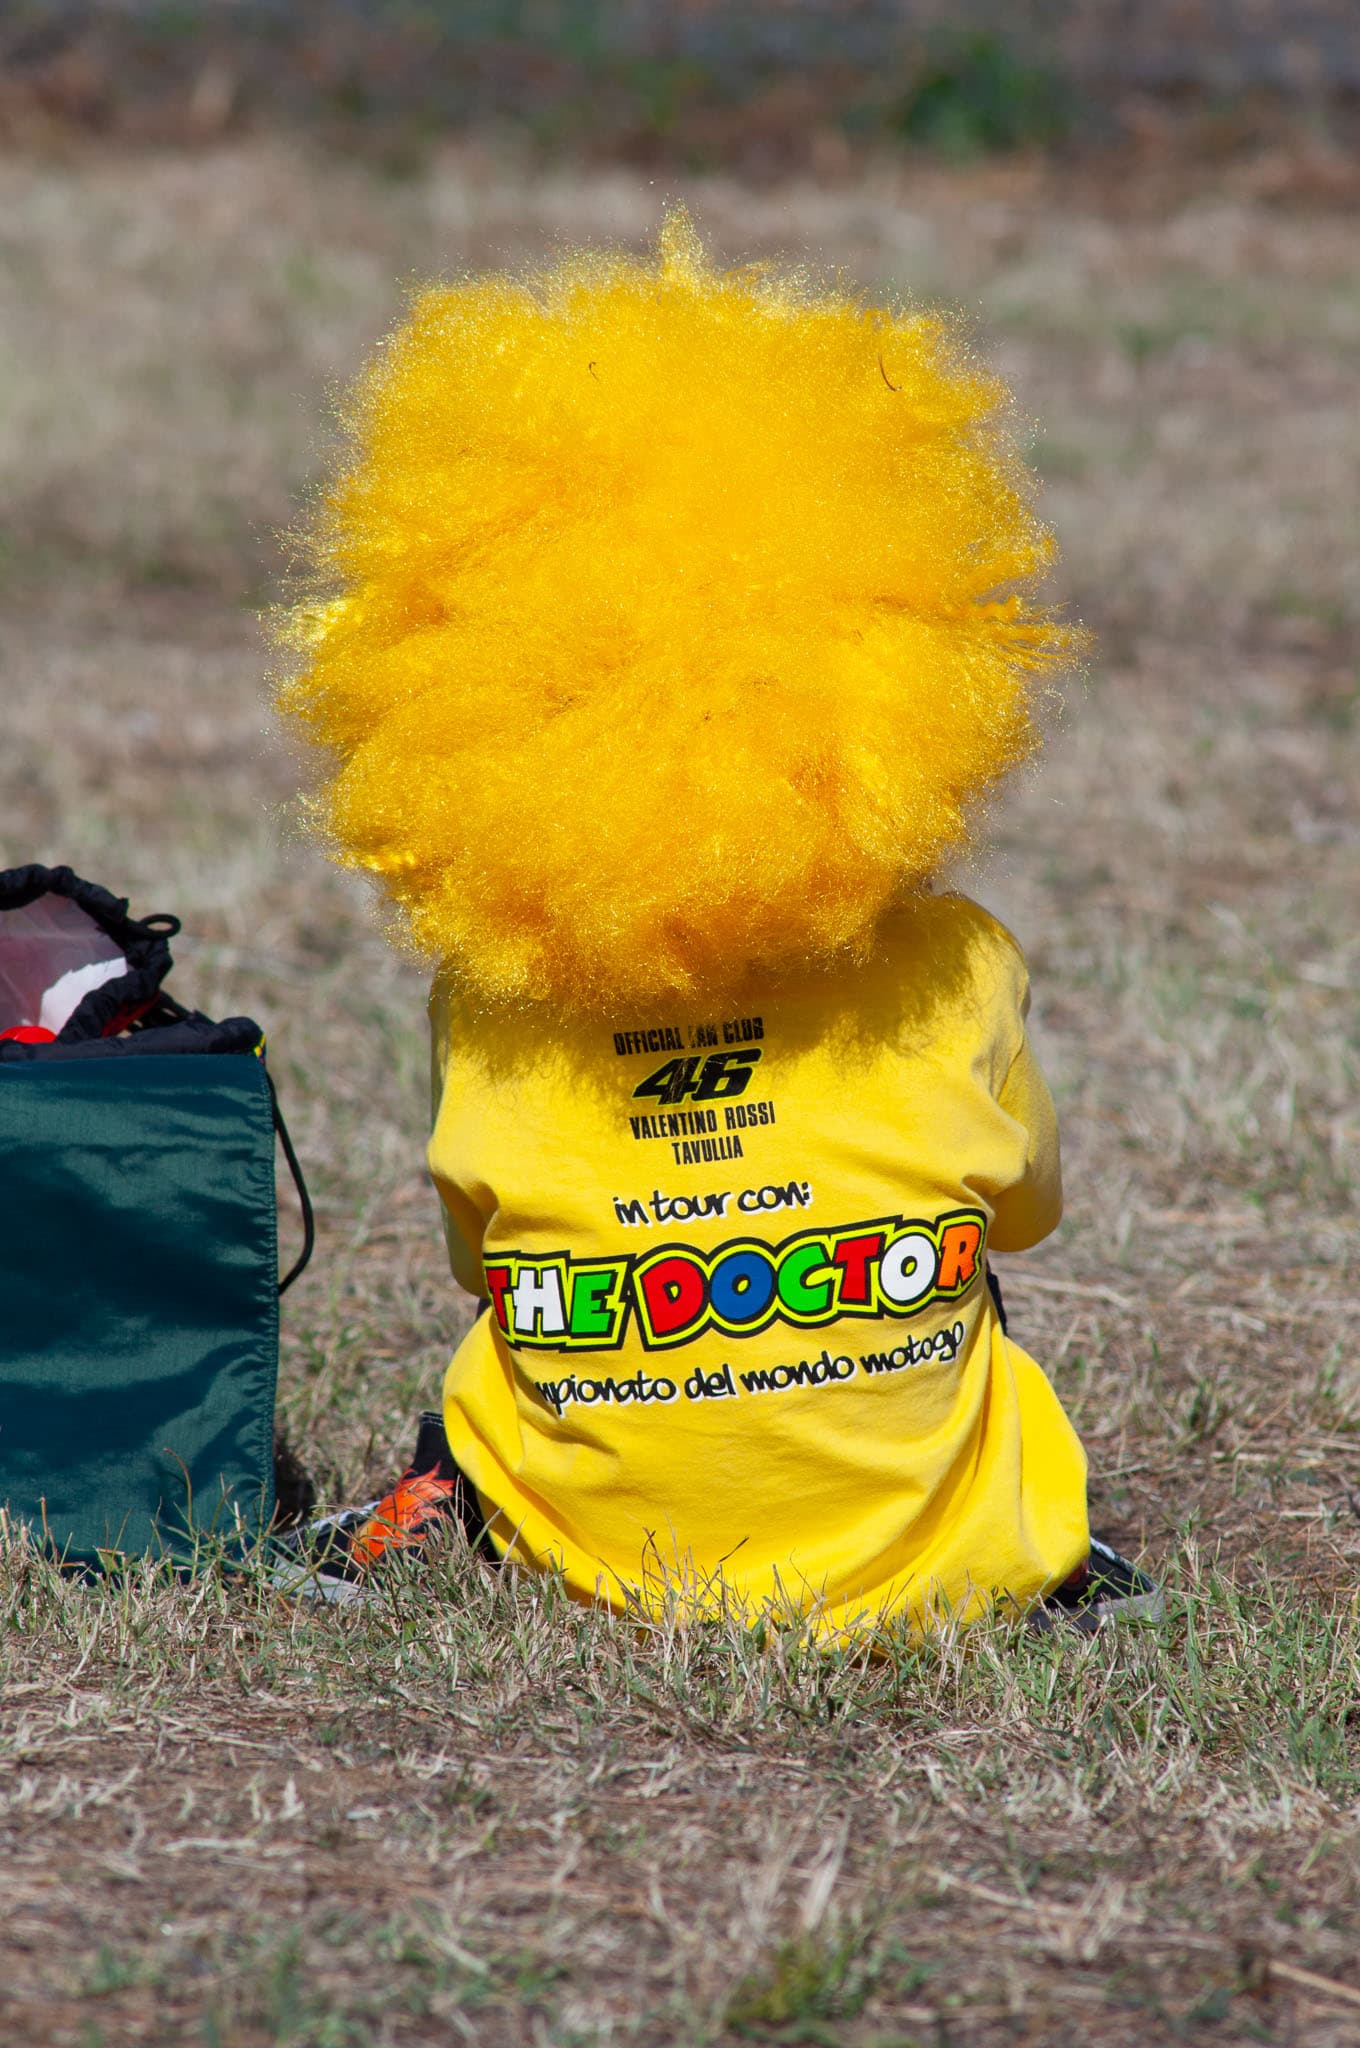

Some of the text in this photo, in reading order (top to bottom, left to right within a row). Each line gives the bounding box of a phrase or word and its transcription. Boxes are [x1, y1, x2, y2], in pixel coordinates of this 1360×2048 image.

[612, 1026, 685, 1056] OFFICIAL
[722, 1016, 764, 1044] CLUB
[631, 1047, 763, 1107] 46
[629, 1101, 776, 1140] VALENTINO ROSSI
[671, 1135, 744, 1166] TAVULLIA
[612, 1196, 652, 1227] in
[649, 1189, 733, 1223] tour
[483, 1212, 986, 1348] THE DOCTOR
[684, 1363, 737, 1400] del
[740, 1350, 856, 1392] mondo
